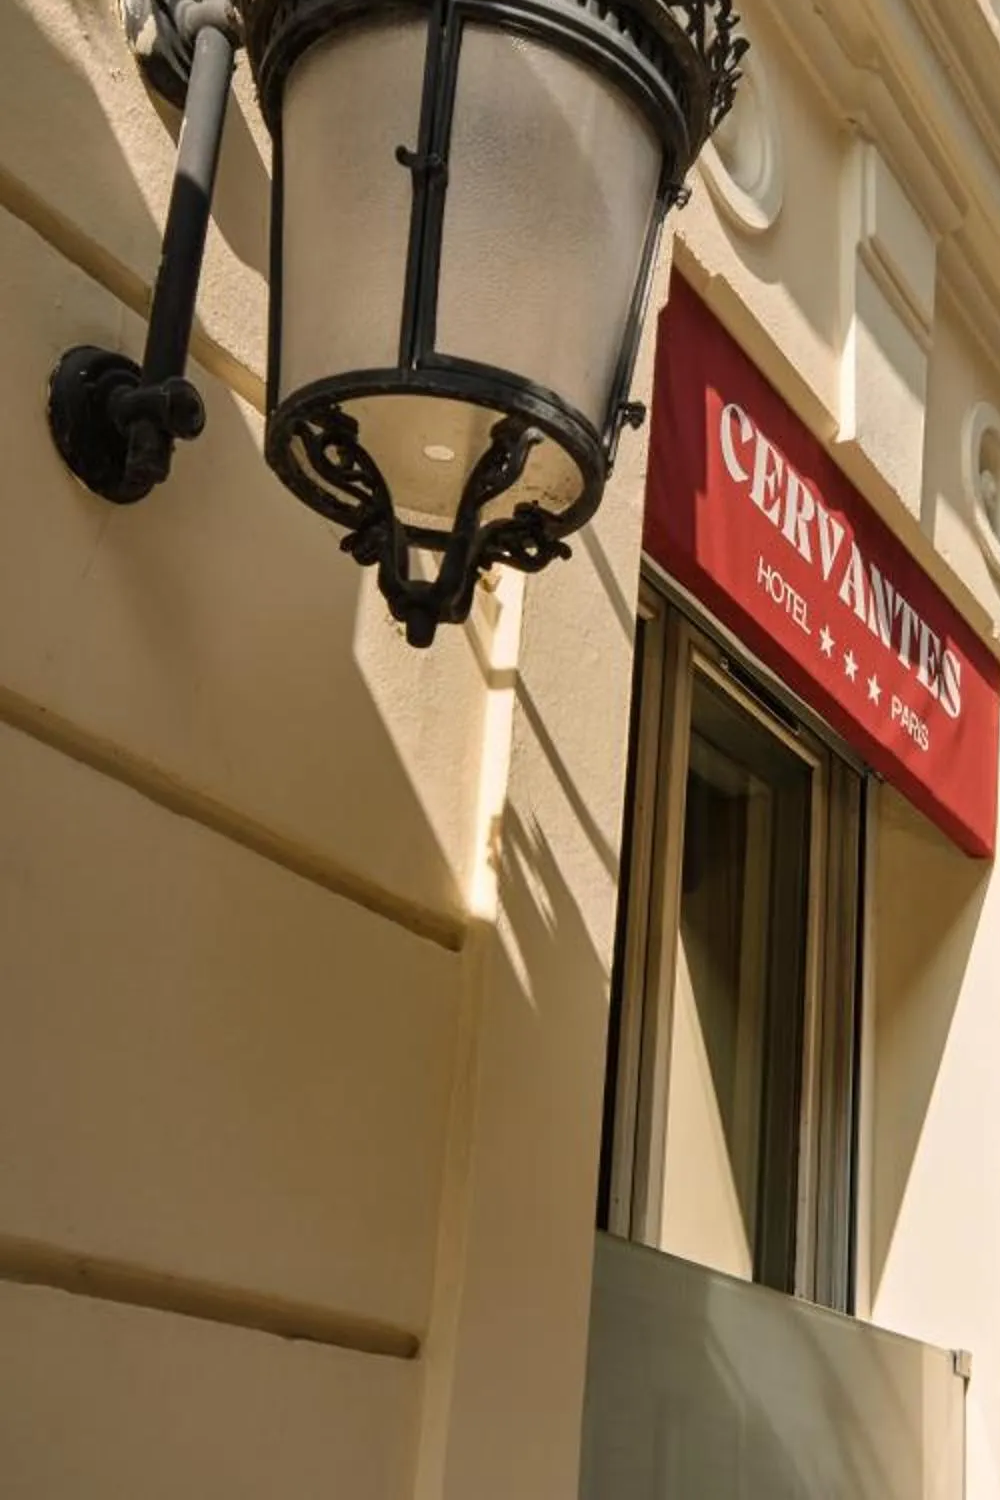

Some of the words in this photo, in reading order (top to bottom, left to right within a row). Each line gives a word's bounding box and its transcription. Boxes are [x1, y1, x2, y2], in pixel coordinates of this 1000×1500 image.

[720, 403, 962, 719] CERVANTES
[757, 556, 811, 635] HOTEL
[891, 695, 929, 751] PARIS
